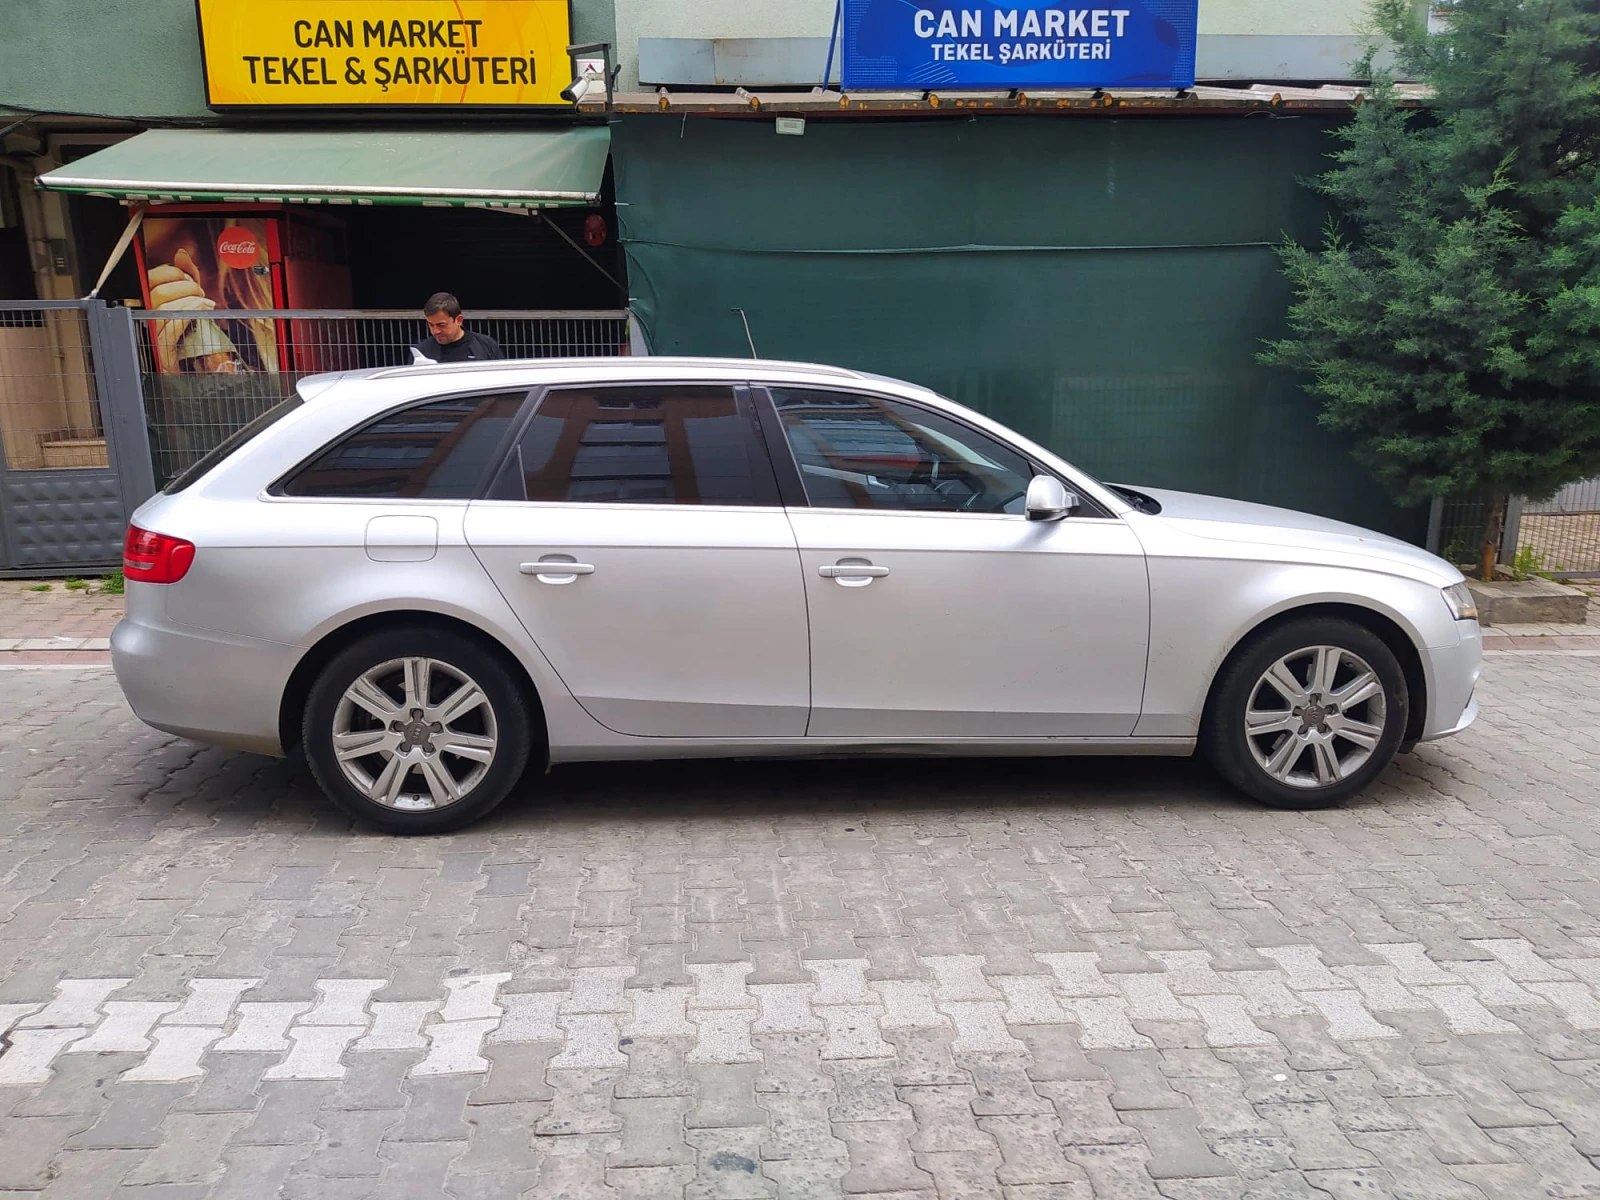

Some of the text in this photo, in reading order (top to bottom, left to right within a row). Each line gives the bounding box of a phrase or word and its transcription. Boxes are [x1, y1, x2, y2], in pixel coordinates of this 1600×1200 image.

[294, 19, 483, 49] CAN MARKET
[913, 9, 1130, 39] CAN MARKET
[931, 38, 1111, 65] TEKEL ŞARKÜTERİ
[242, 50, 537, 93] TEKEL & ŞARKÜTERİ
